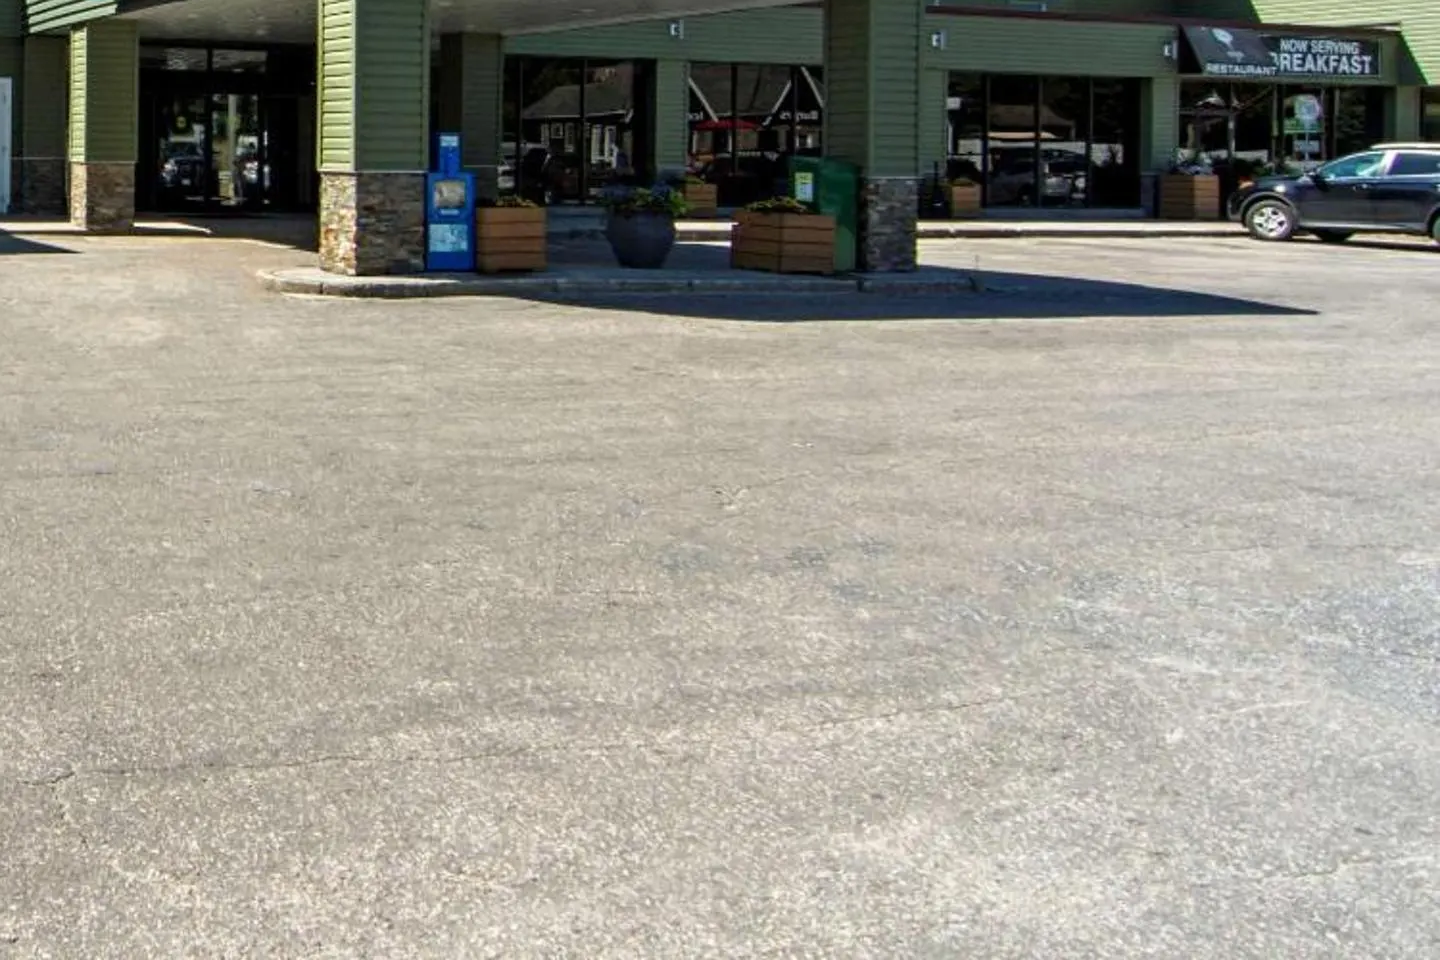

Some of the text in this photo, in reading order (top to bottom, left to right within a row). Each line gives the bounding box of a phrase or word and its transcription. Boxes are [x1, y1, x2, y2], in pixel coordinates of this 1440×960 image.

[1280, 39, 1360, 55] NOW SERVING
[1206, 63, 1278, 76] RESTAURANT
